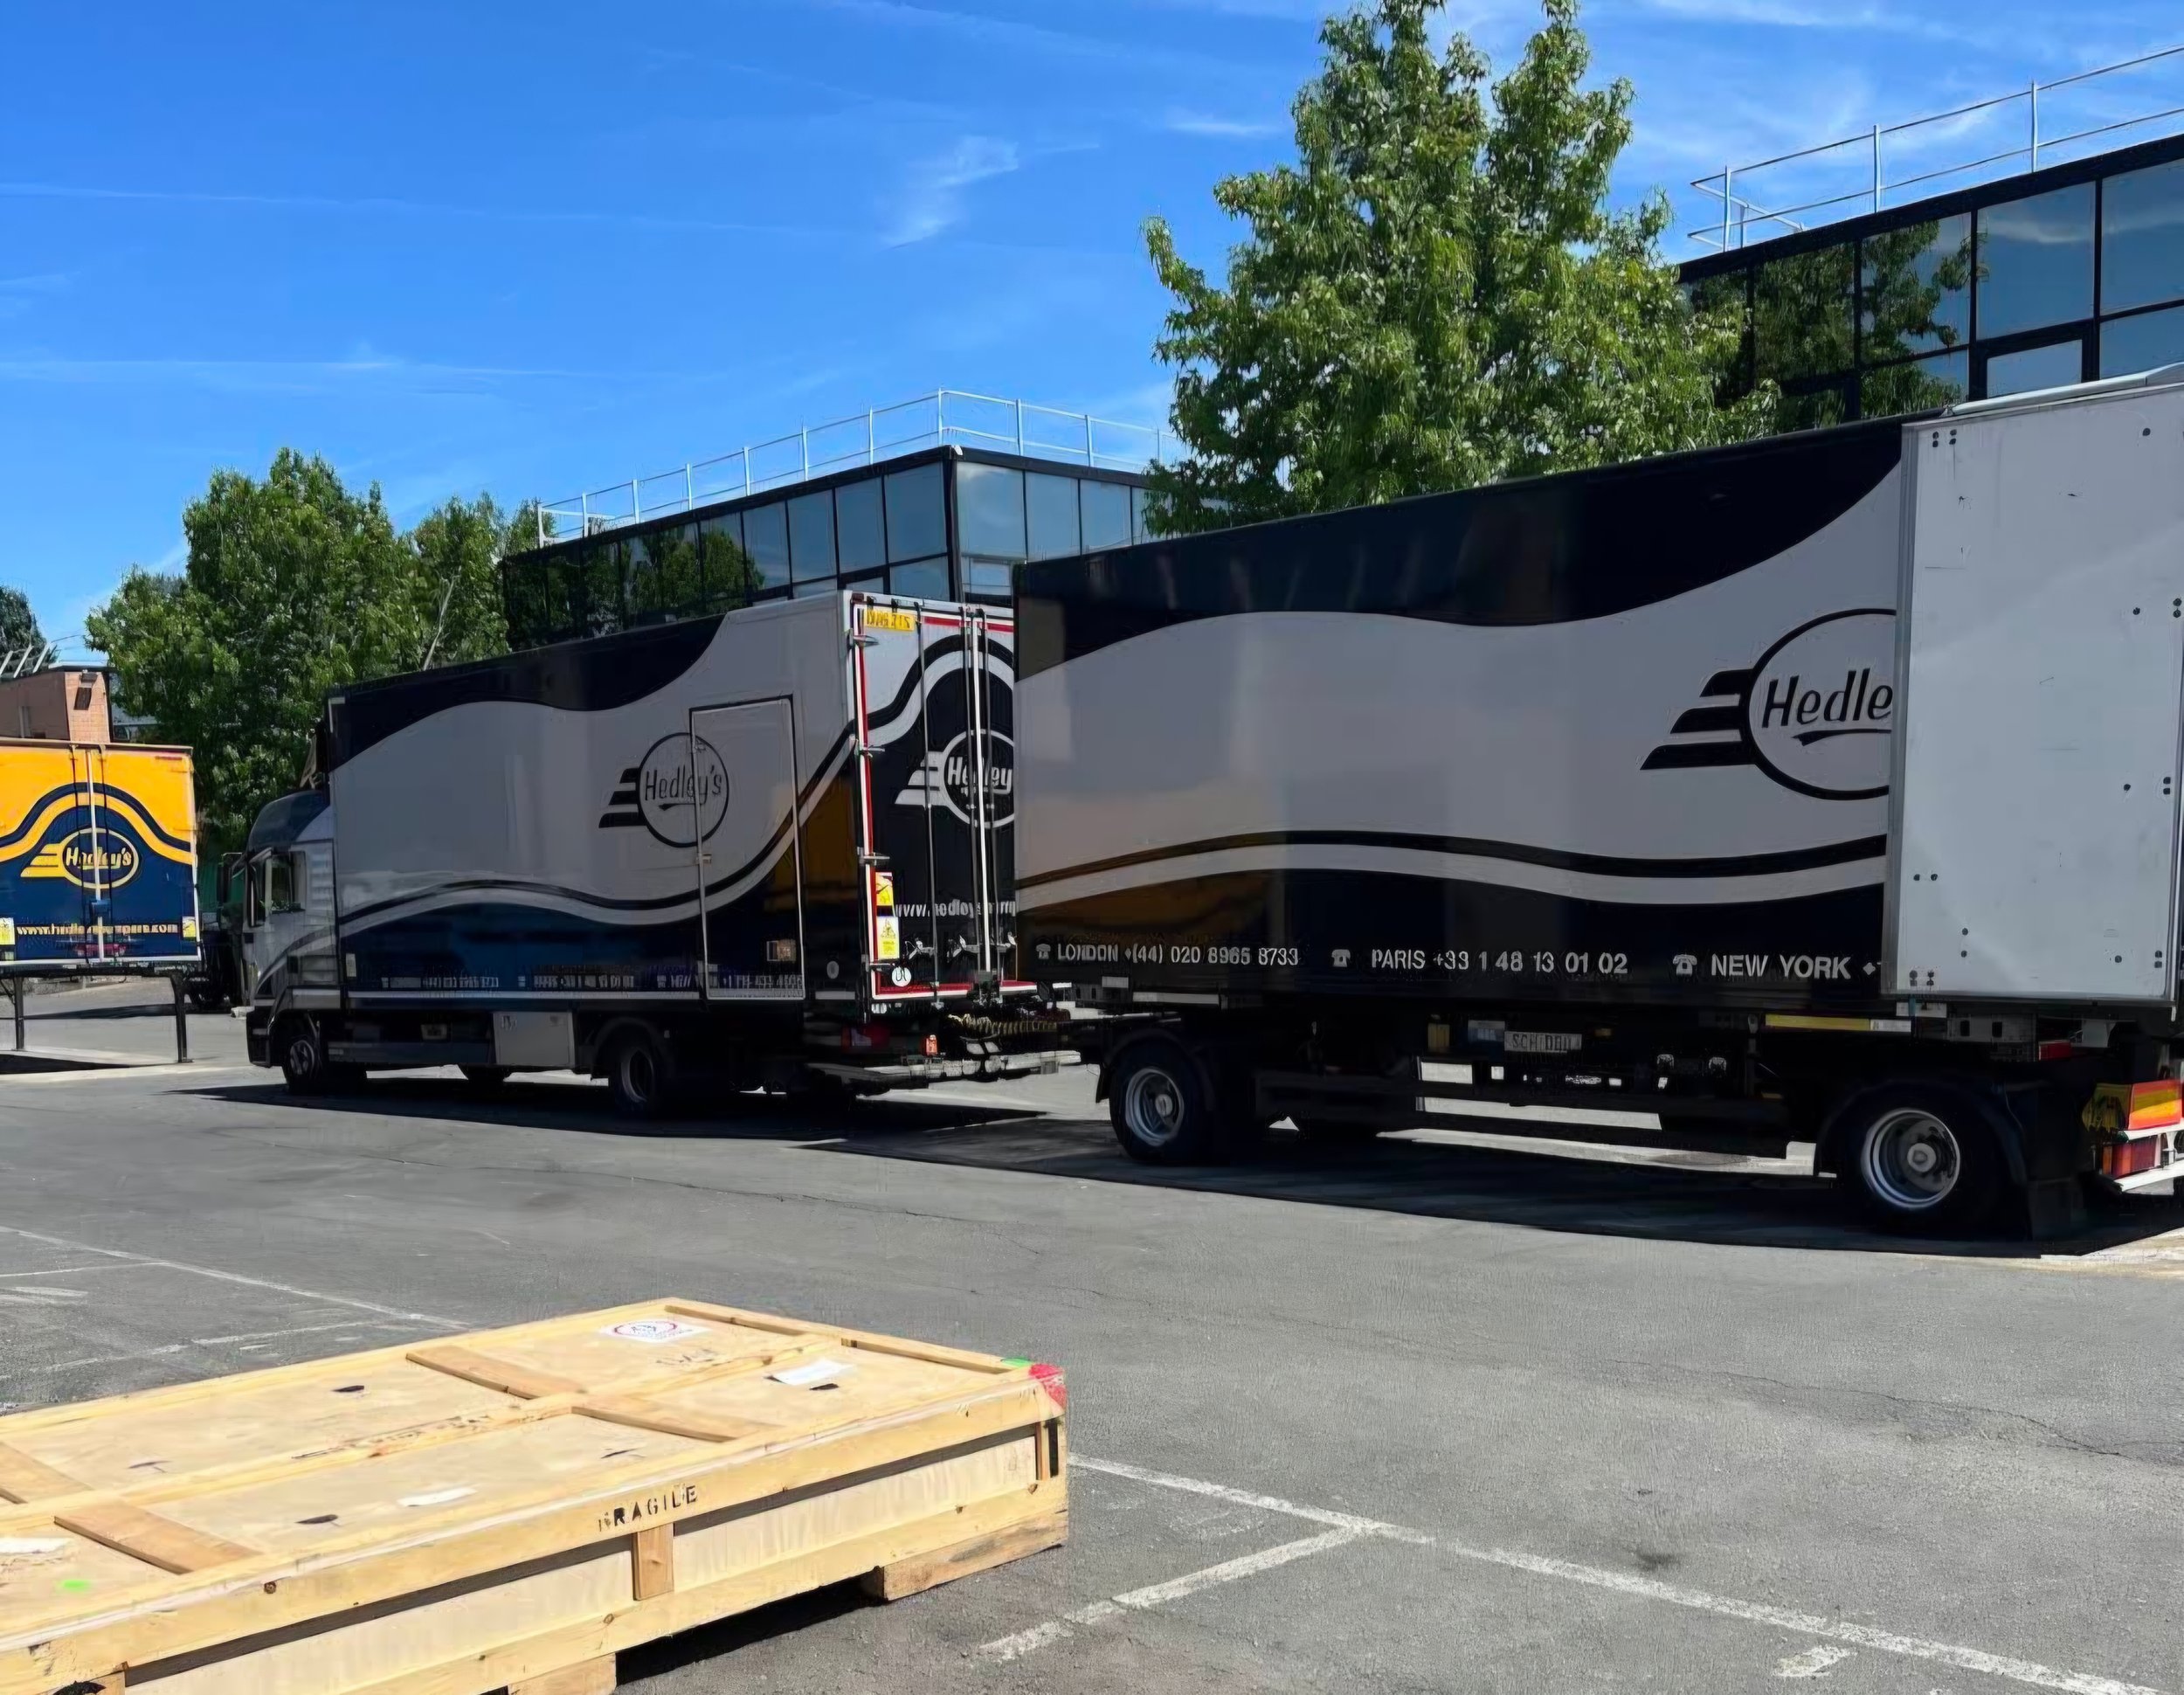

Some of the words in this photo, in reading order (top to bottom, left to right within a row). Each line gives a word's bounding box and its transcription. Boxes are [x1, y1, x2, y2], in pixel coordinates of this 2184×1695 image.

[645, 764, 722, 805] Hedley's
[1057, 944, 1118, 962] LONDON
[1124, 944, 1163, 964] +(44)
[1171, 945, 1200, 963] 020
[1258, 947, 1298, 965] 8733
[1372, 949, 1425, 970] PARIS
[1433, 950, 1469, 971] +33
[1478, 951, 1487, 972] 1
[1496, 951, 1523, 972] 48
[1533, 951, 1554, 972] 13
[1565, 951, 1588, 973] 01
[1599, 951, 1628, 974] 02
[1711, 953, 1768, 977] NEW
[1780, 954, 1850, 979] YORK
